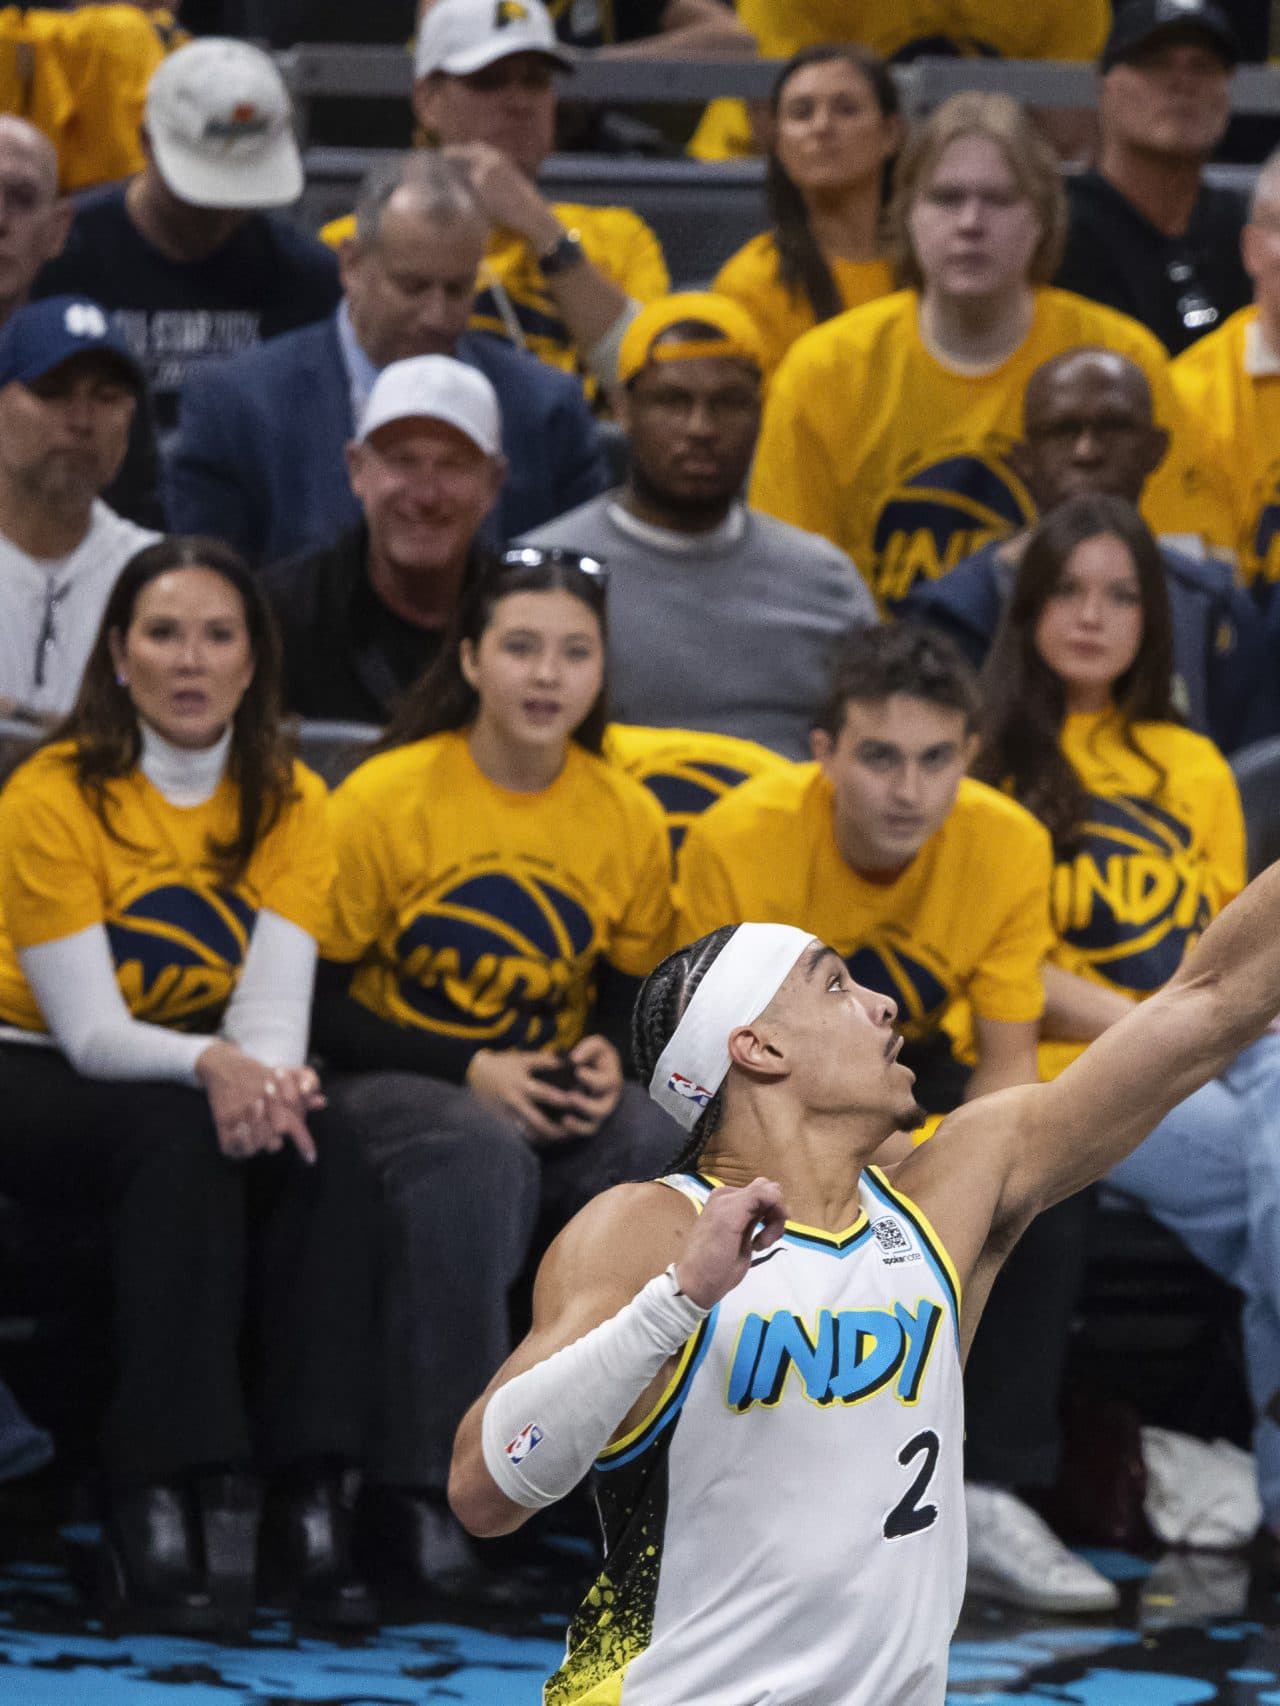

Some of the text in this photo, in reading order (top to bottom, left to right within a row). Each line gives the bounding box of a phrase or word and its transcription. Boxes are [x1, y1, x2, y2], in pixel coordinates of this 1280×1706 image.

[1053, 853, 1212, 932] INDY
[724, 1296, 944, 1416] INDY
[881, 1427, 941, 1542] 2
